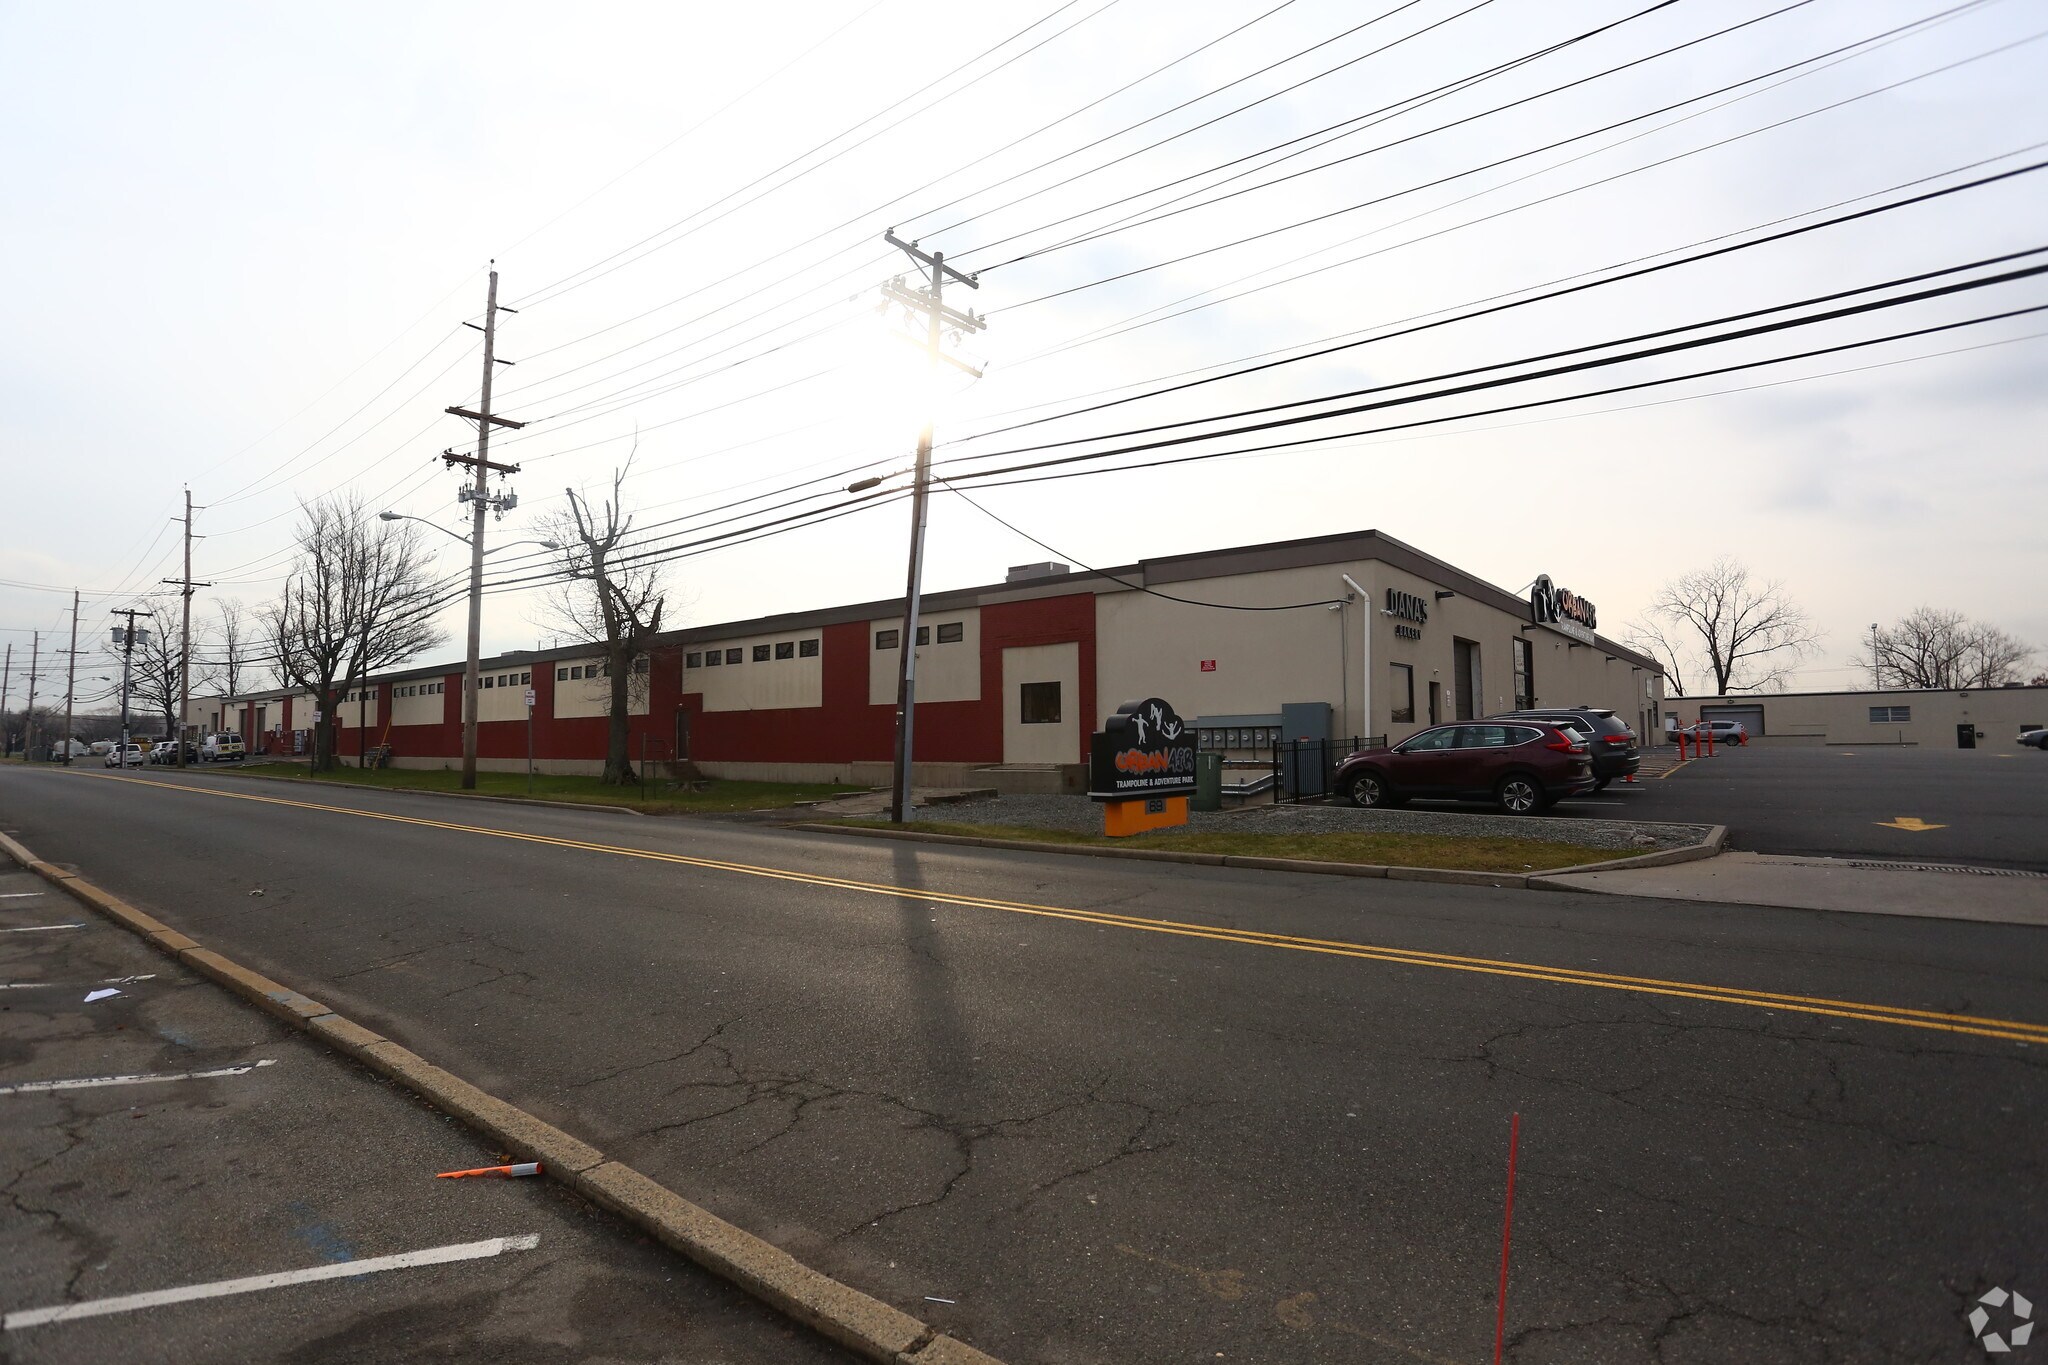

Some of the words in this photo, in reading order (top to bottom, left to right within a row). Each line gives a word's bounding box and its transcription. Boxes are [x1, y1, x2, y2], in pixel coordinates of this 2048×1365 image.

[1387, 588, 1428, 624] DANA'S
[1115, 746, 1168, 775] URBAN
[1116, 778, 1149, 789] TRAMPOLINE
[1149, 778, 1154, 786] &
[1154, 776, 1181, 786] ADVENTURE
[1182, 775, 1194, 784] PARK
